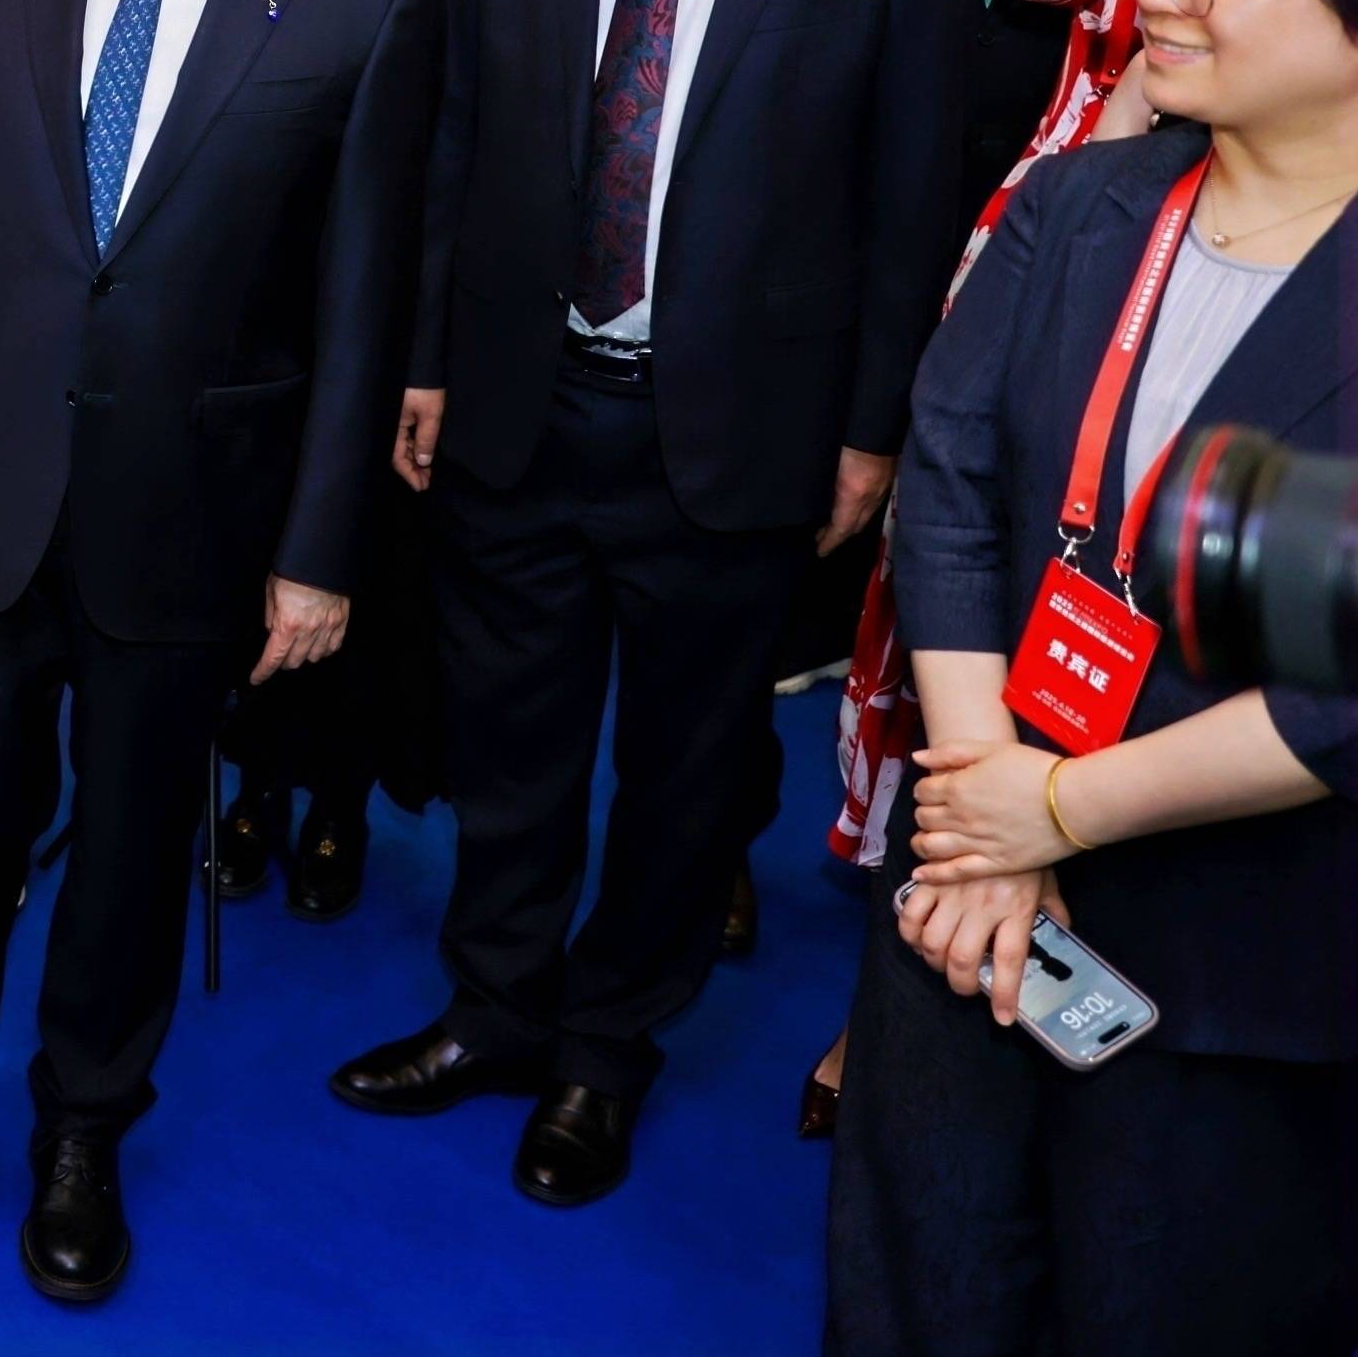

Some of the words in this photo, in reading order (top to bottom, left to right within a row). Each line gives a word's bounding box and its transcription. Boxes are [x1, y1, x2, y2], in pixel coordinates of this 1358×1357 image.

[1046, 638, 1110, 694] 贵宾证
[1060, 992, 1114, 1030] 10:16
